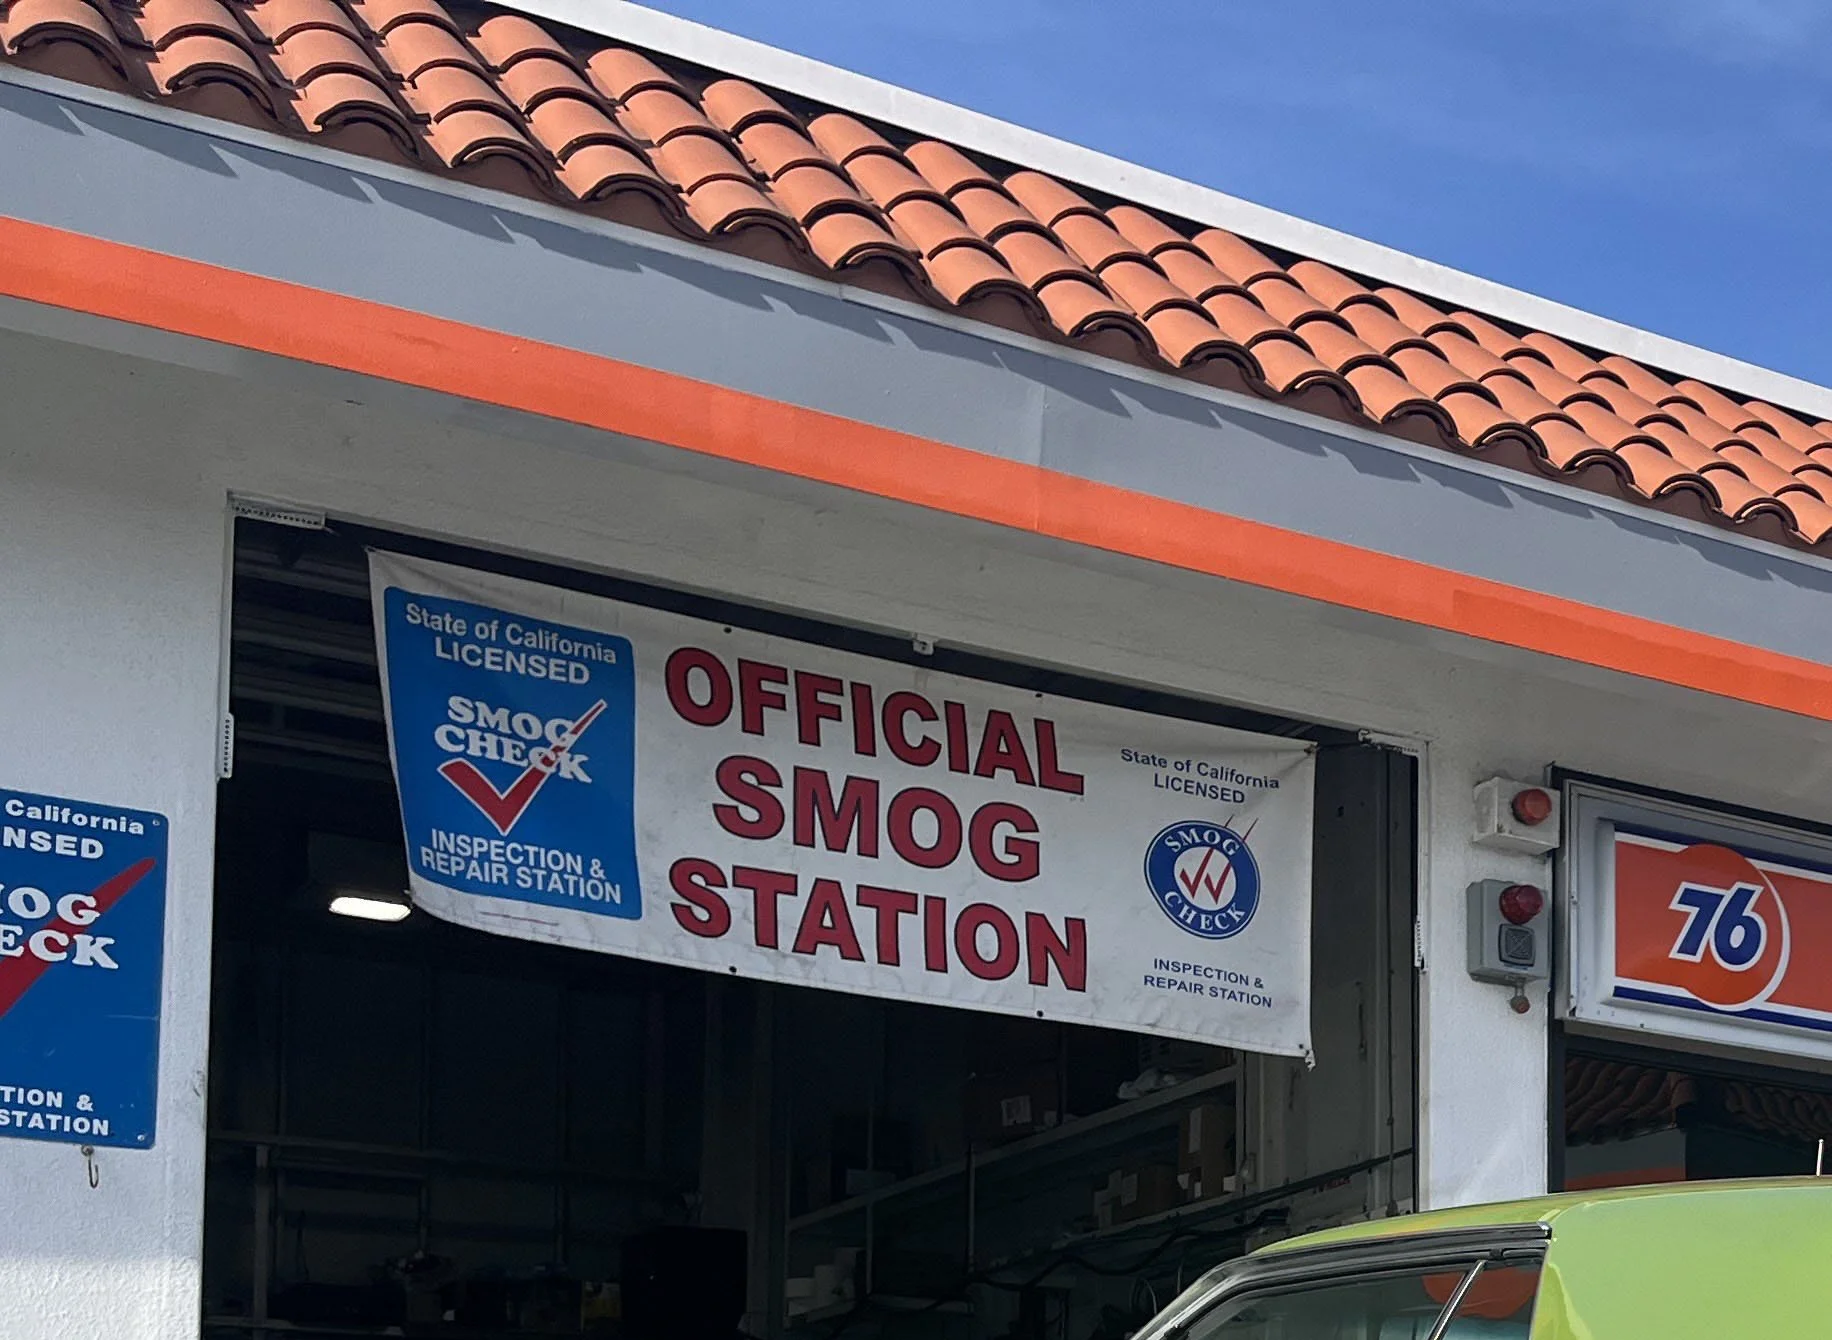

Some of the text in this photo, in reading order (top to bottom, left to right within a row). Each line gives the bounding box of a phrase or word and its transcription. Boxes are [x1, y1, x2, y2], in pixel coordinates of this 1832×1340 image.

[405, 603, 617, 665] State of California
[435, 636, 591, 685] LICENSED
[447, 695, 577, 747] SMOG
[664, 646, 1085, 796] OFFICIAL
[434, 723, 593, 784] CHECK
[1120, 748, 1280, 789] State of California
[1154, 773, 1246, 804] LICENSED
[5, 798, 144, 835] California
[712, 754, 1041, 882] SMOG
[2, 826, 104, 860] NSED
[431, 828, 606, 880] INSPECTION &
[1164, 827, 1240, 857] SMOG
[420, 845, 622, 905] REPAIR STATION
[0, 884, 100, 927] OG
[668, 857, 1087, 993] STATION
[1164, 891, 1247, 931] CHECK
[1669, 881, 1767, 972] 76
[1143, 975, 1272, 1008] REPAIR STATION
[1153, 958, 1264, 989] INSPECTION &
[0, 1108, 109, 1136] STATION
[76, 1094, 94, 1112] &
